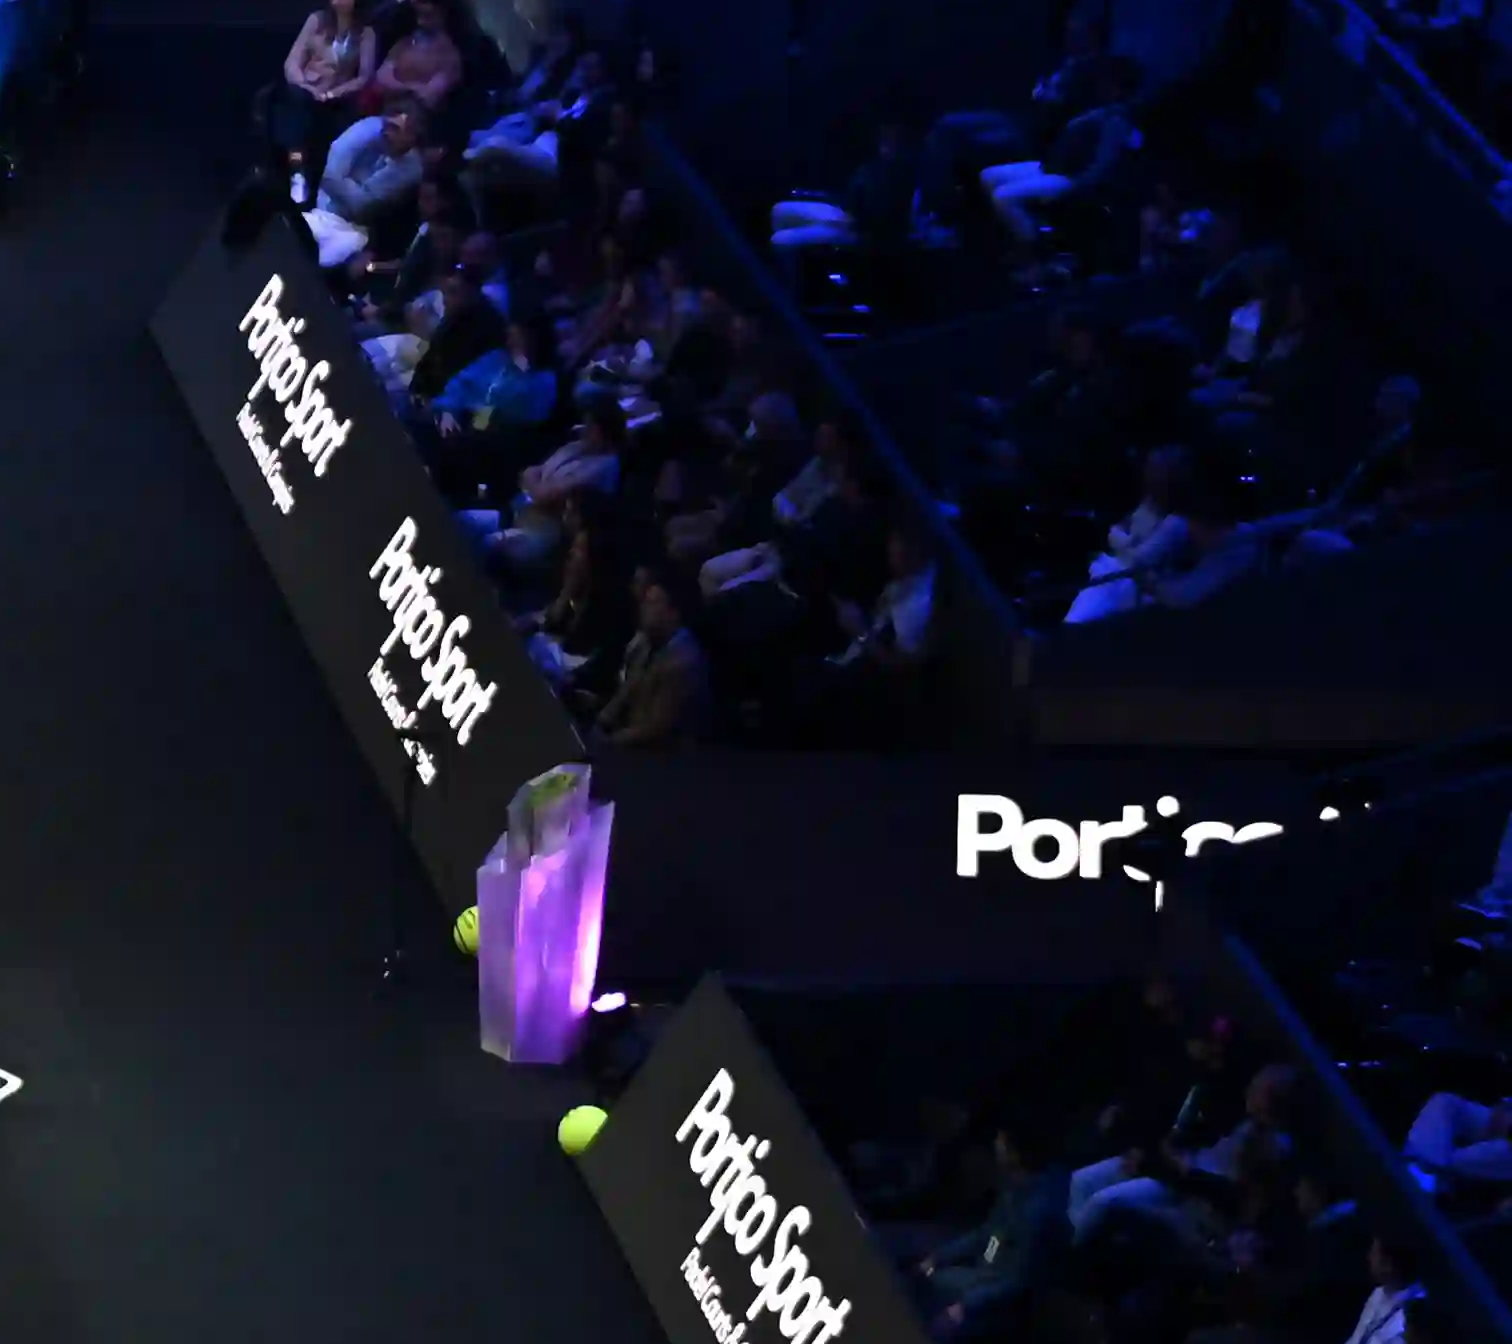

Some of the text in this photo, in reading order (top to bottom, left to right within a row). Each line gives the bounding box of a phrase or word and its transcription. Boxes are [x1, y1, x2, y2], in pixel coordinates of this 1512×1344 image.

[280, 360, 353, 477] Sport
[368, 515, 445, 660] Portico
[416, 615, 498, 746] Sport
[675, 1067, 777, 1256] Portico
